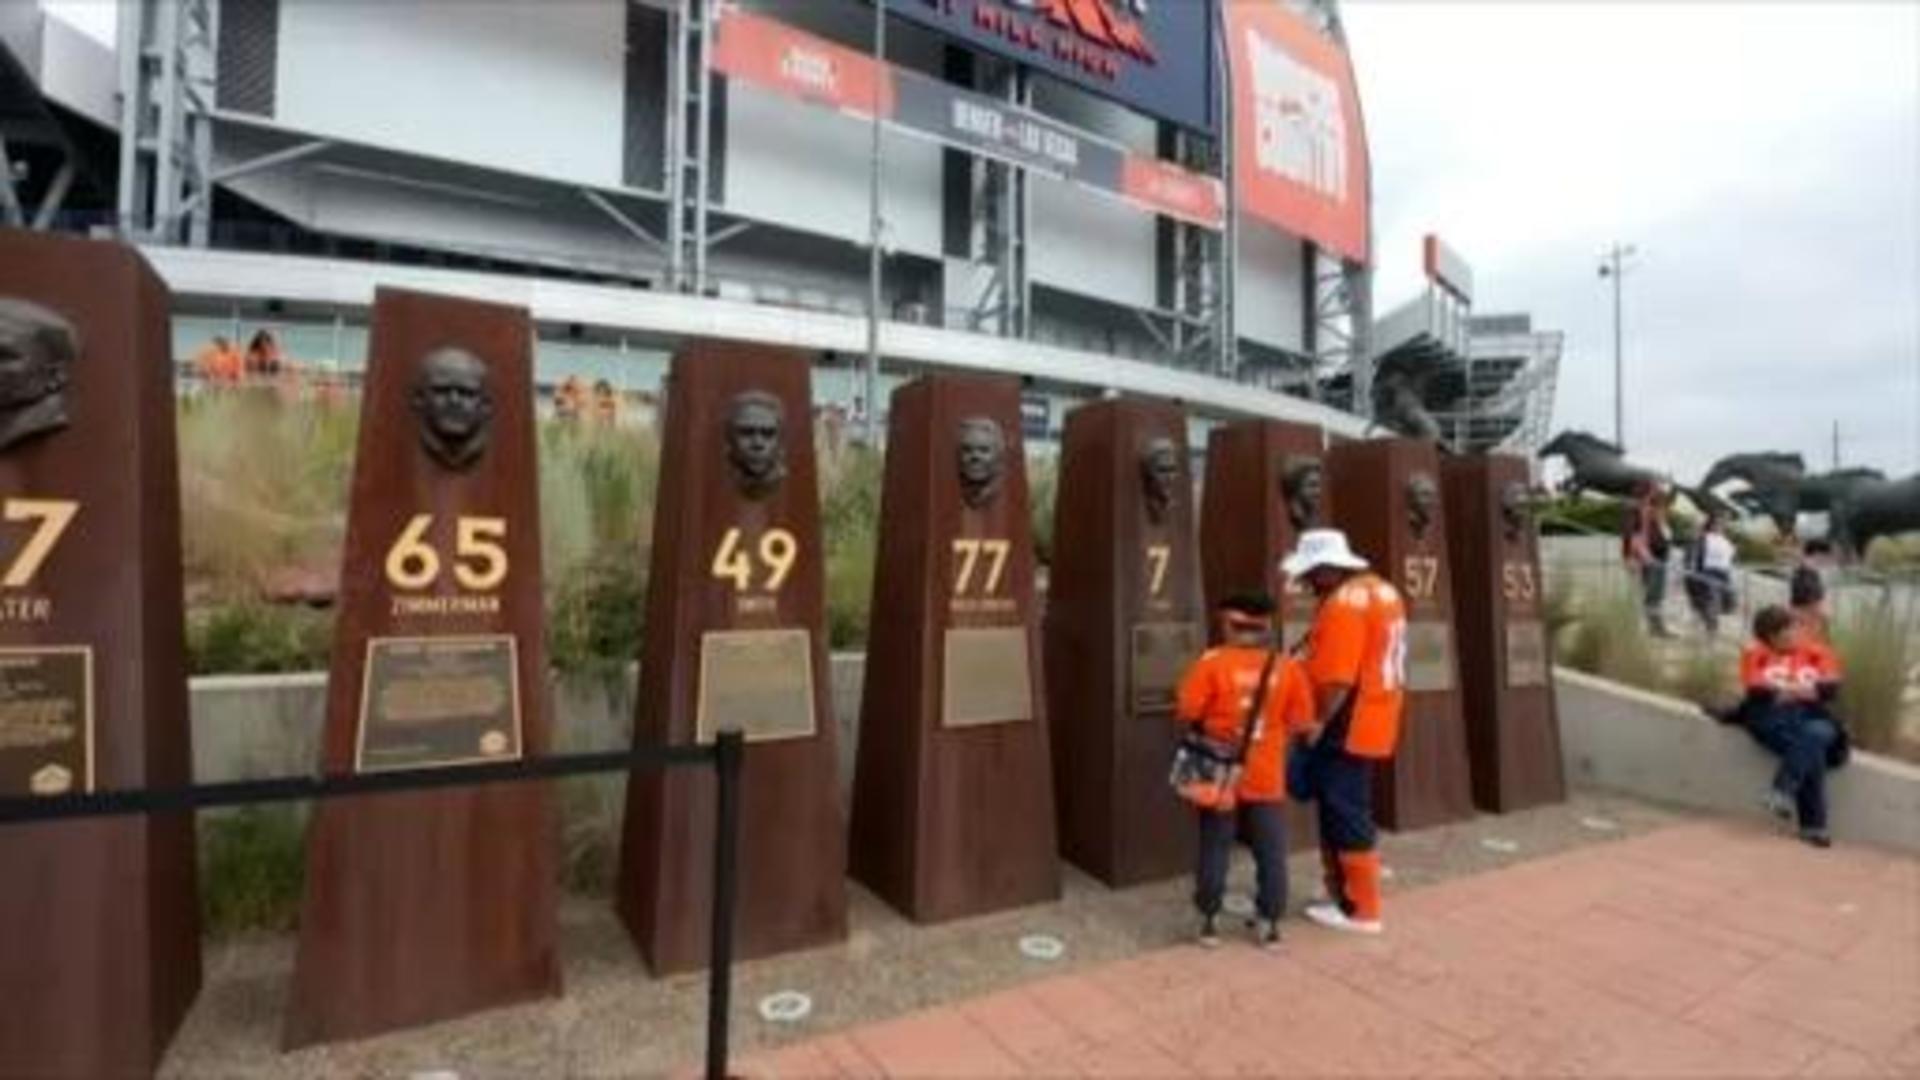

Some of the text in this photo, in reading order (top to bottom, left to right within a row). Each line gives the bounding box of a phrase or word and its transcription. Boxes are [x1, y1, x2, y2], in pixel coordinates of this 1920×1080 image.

[385, 513, 508, 589] 65
[711, 527, 797, 592] 49
[951, 538, 1011, 595] 77
[1146, 546, 1171, 594] 7
[1404, 556, 1438, 597] 57
[1502, 564, 1536, 599] 53
